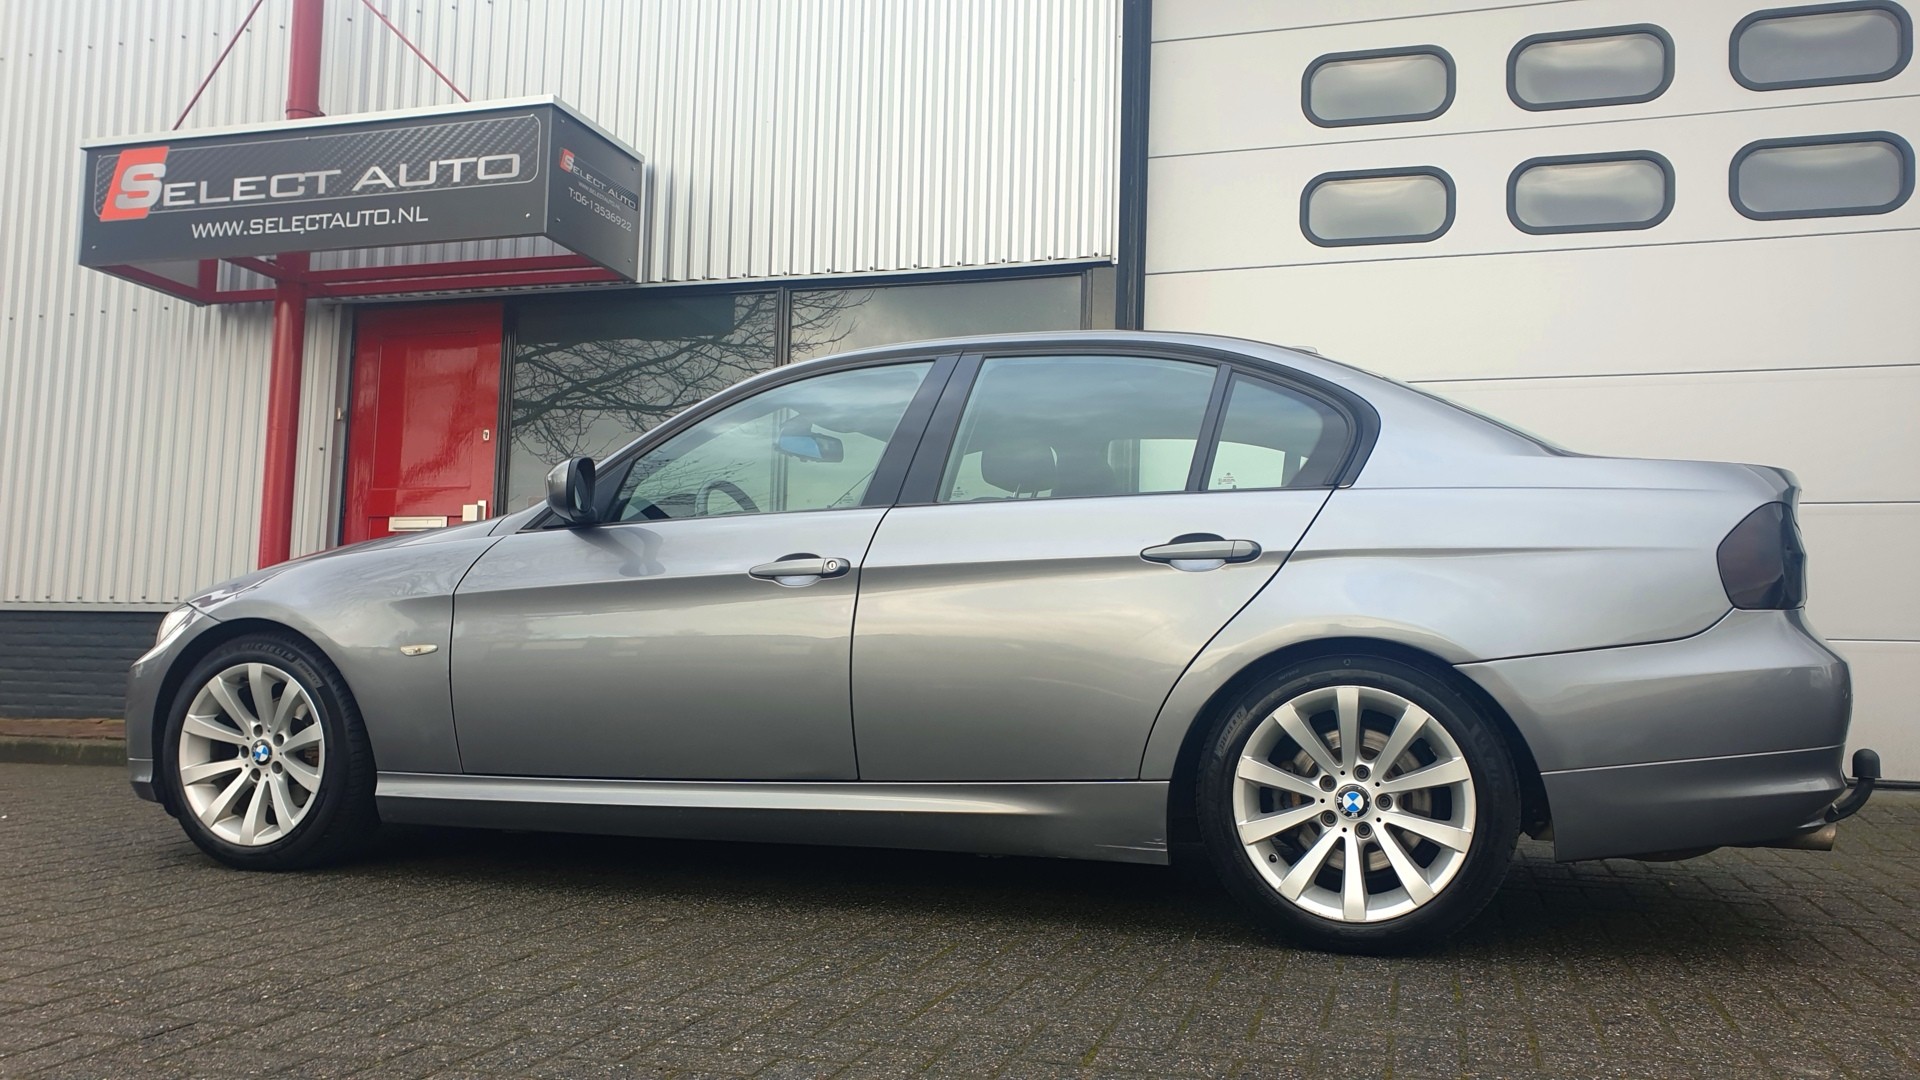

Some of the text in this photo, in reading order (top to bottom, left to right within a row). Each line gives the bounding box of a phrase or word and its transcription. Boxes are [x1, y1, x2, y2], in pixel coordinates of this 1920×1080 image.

[115, 153, 520, 210] SELECT AUTO
[563, 154, 636, 210] SELECT AUTO
[191, 205, 429, 239] WWW.SELECTAUTO.NL
